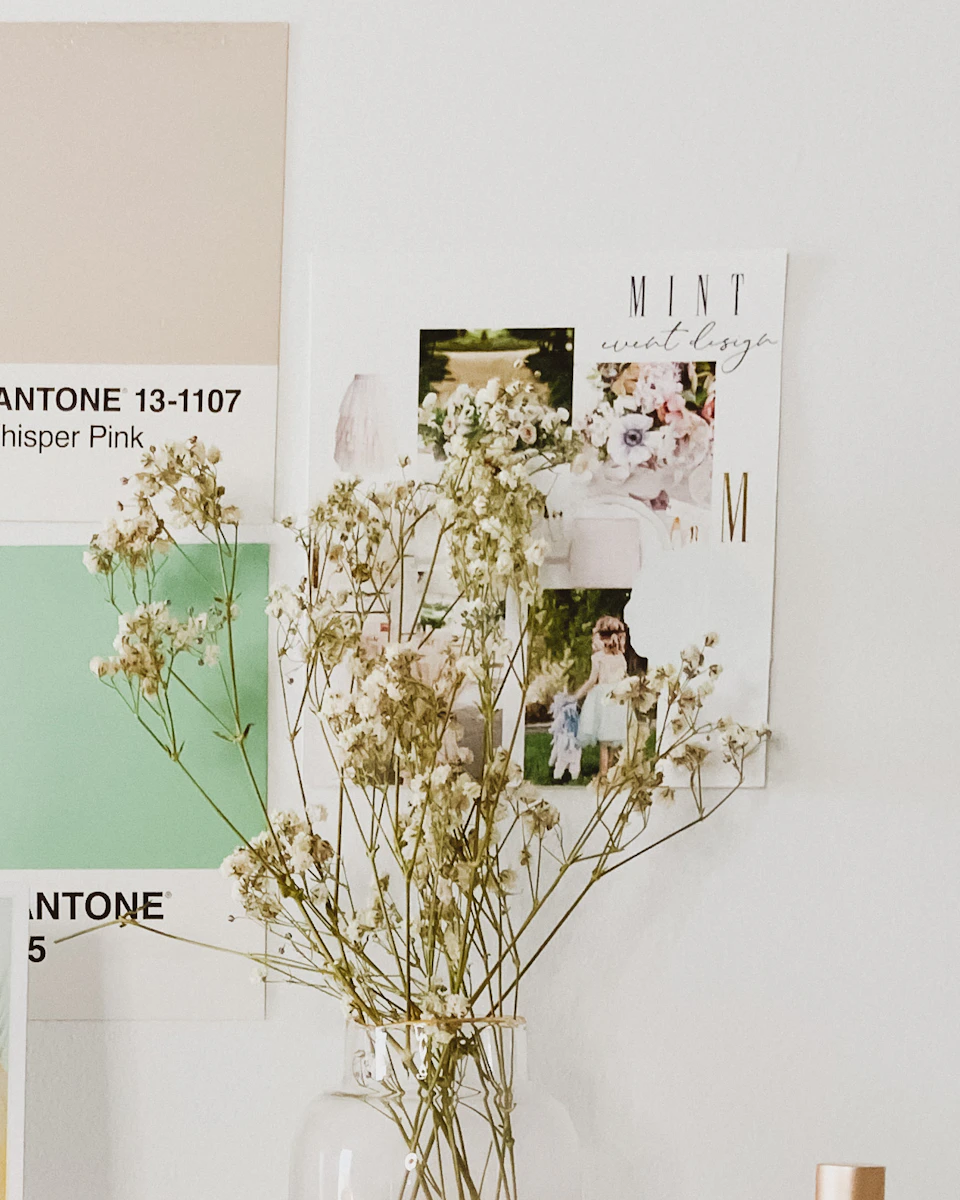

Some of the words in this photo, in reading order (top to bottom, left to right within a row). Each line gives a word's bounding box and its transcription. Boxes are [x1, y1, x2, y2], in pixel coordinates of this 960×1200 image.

[629, 273, 745, 318] MINT
[689, 321, 778, 374] design
[135, 388, 241, 413] 13-1107
[90, 425, 144, 449] Pink
[721, 472, 748, 543] M
[28, 891, 164, 920] NTONE
